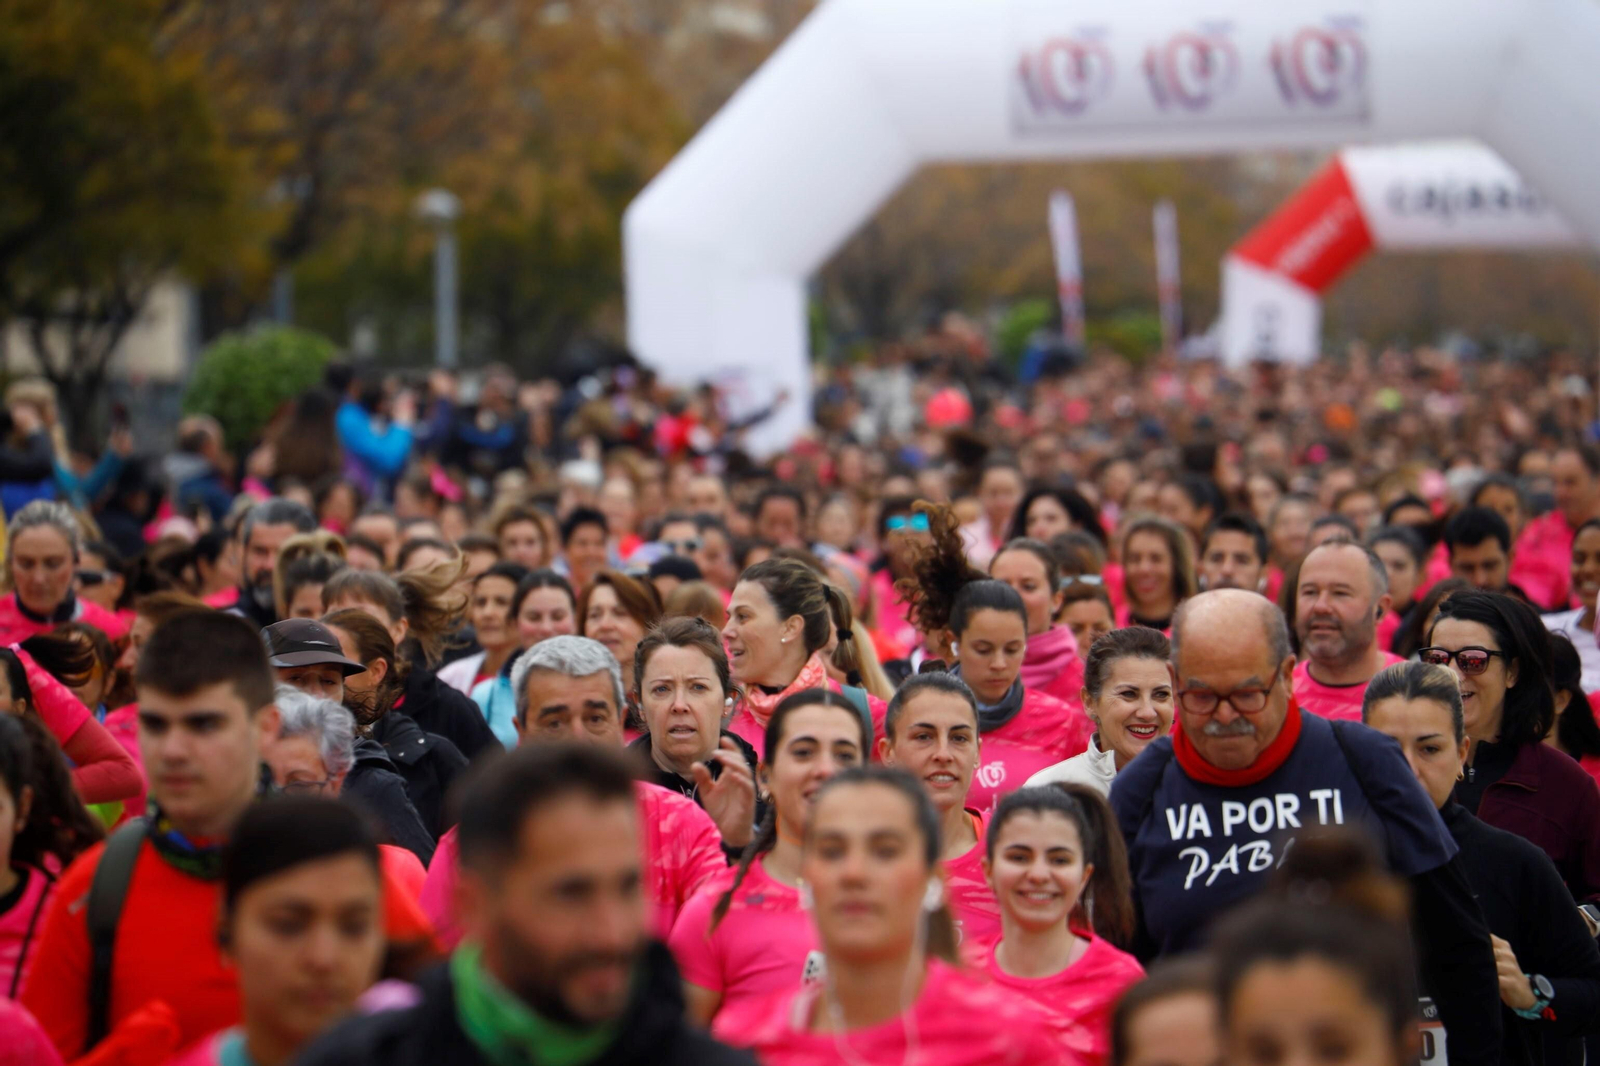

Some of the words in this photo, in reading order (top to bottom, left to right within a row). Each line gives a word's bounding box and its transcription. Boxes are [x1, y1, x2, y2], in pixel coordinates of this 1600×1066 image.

[1165, 803, 1212, 840] VA
[1222, 793, 1302, 837] POR
[1309, 788, 1344, 825] TI
